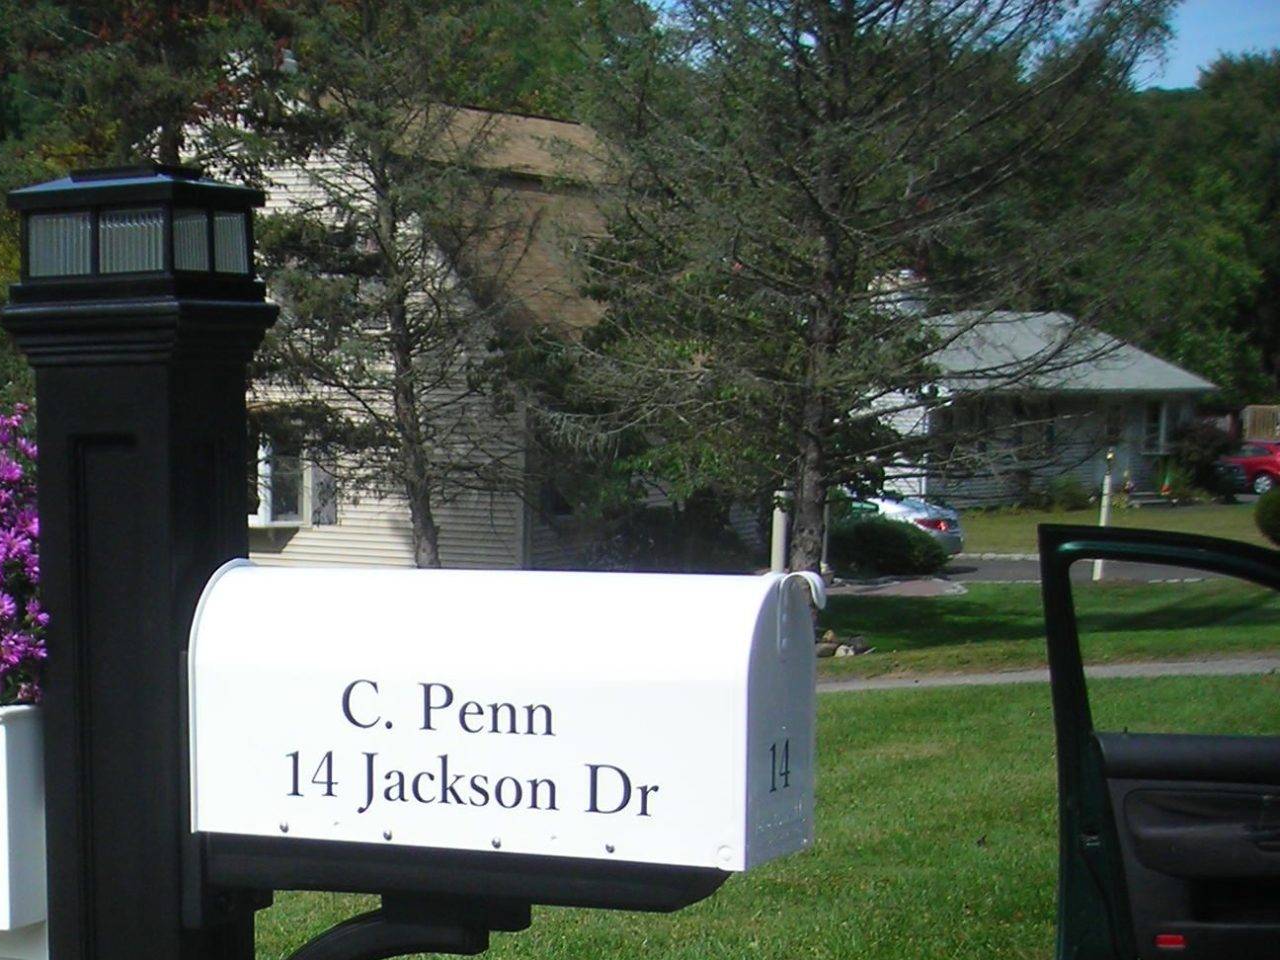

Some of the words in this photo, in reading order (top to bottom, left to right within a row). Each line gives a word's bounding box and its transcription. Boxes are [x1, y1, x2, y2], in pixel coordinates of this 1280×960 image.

[341, 679, 393, 730] C.
[419, 682, 556, 737] Penn
[285, 750, 339, 798] 14
[356, 753, 560, 814] Jackson
[584, 763, 660, 818] Dr
[769, 738, 791, 793] 14
